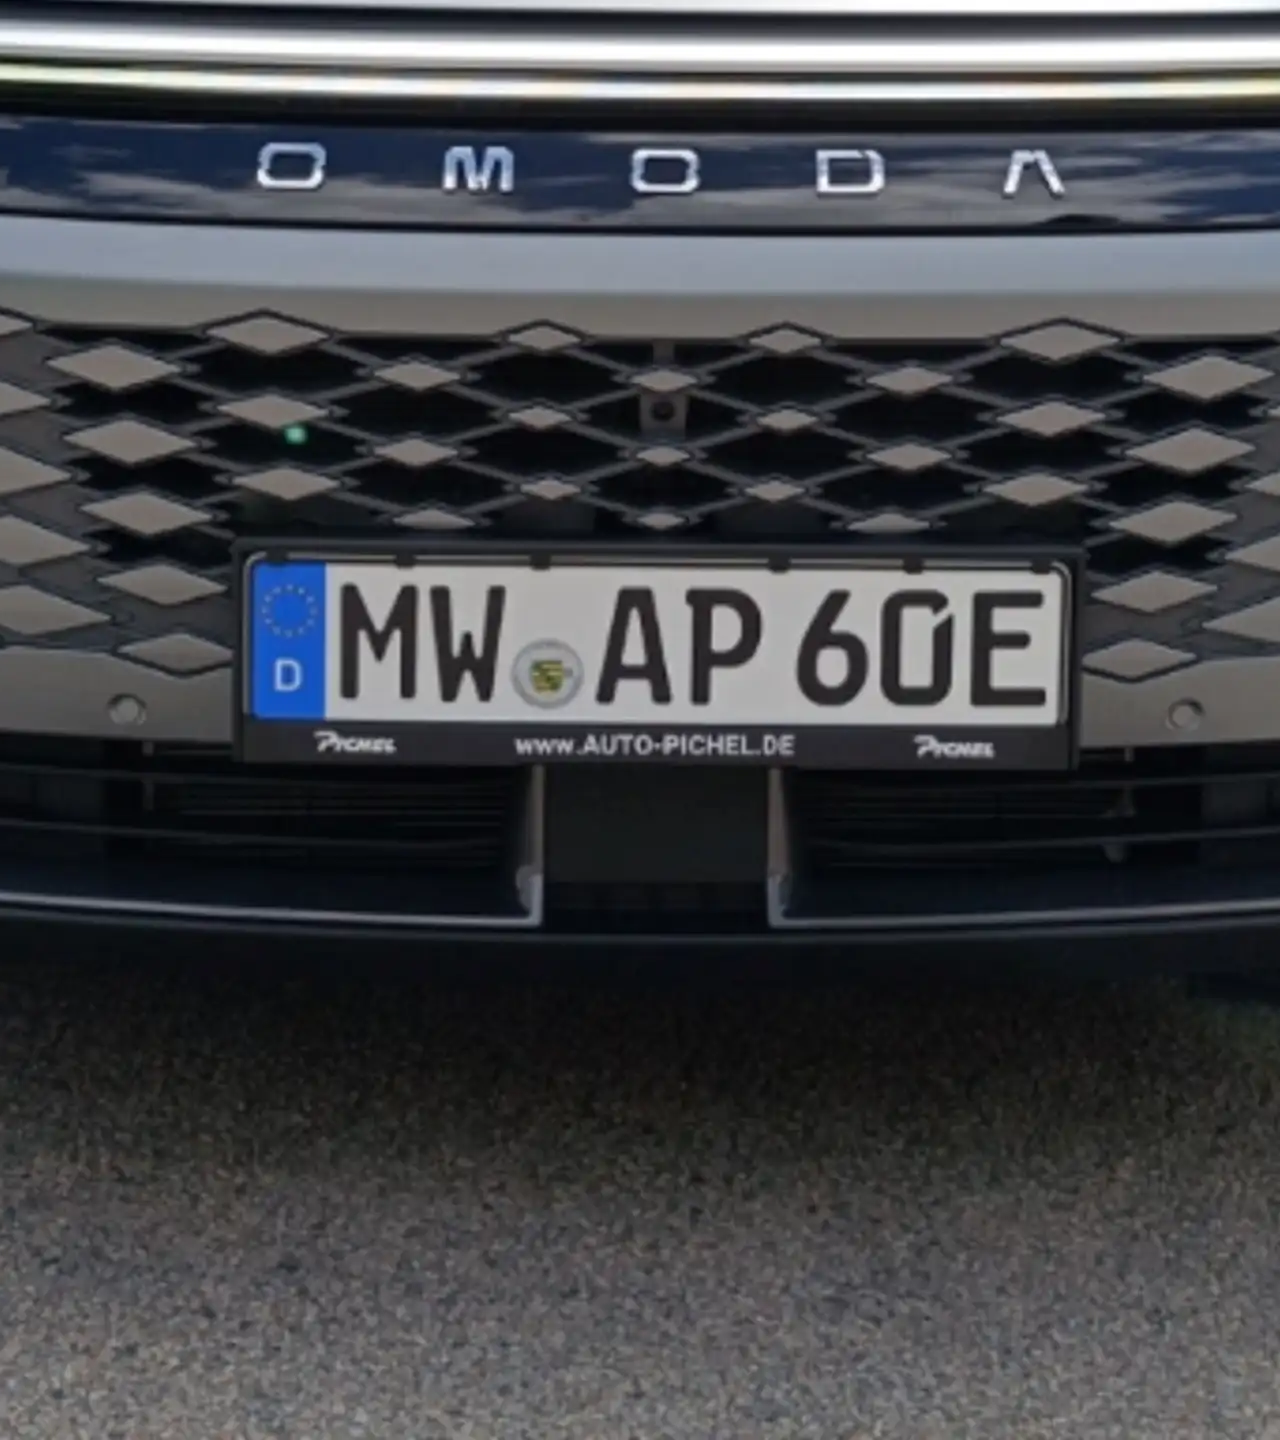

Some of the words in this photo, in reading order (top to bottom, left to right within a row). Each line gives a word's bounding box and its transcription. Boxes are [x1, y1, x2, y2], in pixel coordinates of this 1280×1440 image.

[257, 142, 1066, 196] OMODA
[340, 583, 507, 703] MW
[596, 587, 763, 707] AP
[796, 589, 1048, 708] 60E
[274, 658, 304, 692] D
[515, 733, 795, 757] www.AUTO-PICHEL.DE
